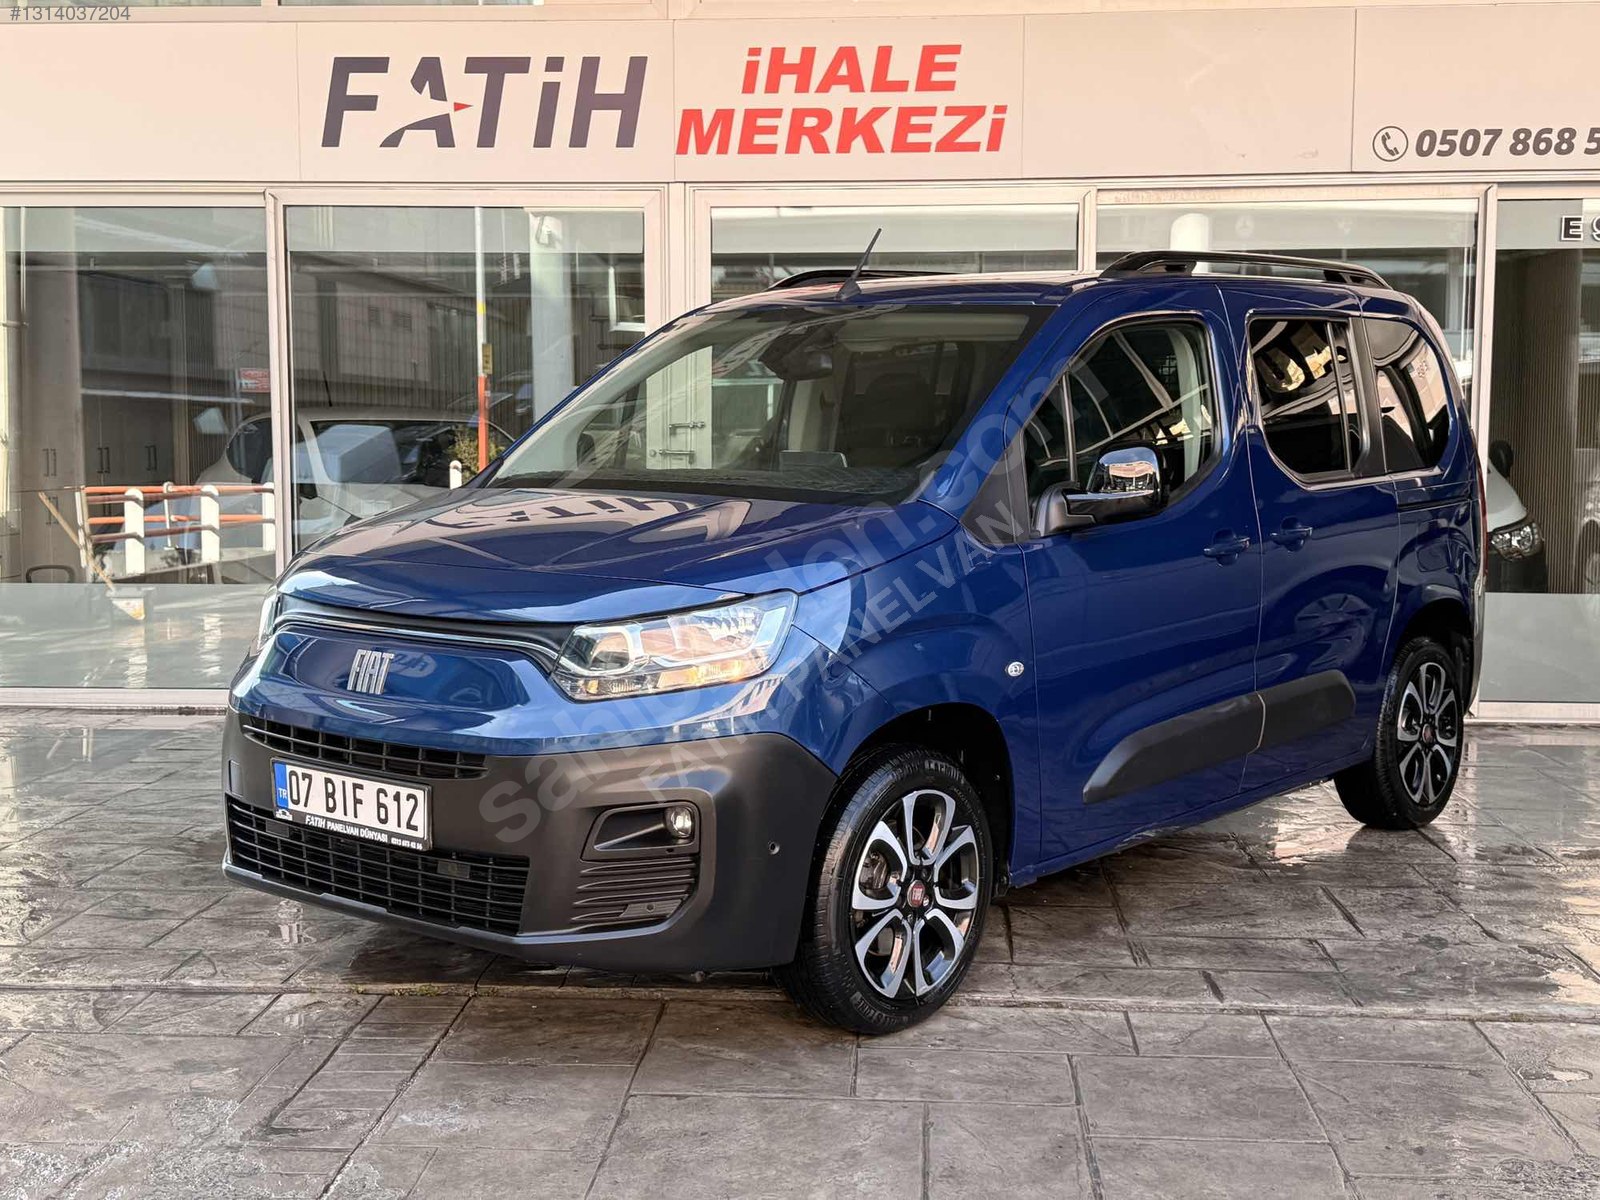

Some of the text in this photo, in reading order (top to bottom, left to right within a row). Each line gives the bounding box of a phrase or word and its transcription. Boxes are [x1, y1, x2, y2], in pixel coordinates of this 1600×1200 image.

[1415, 129, 1503, 157] 0507
[1509, 127, 1577, 156] 868
[346, 649, 395, 695] FIAT
[288, 770, 419, 832] 07 BIF 612
